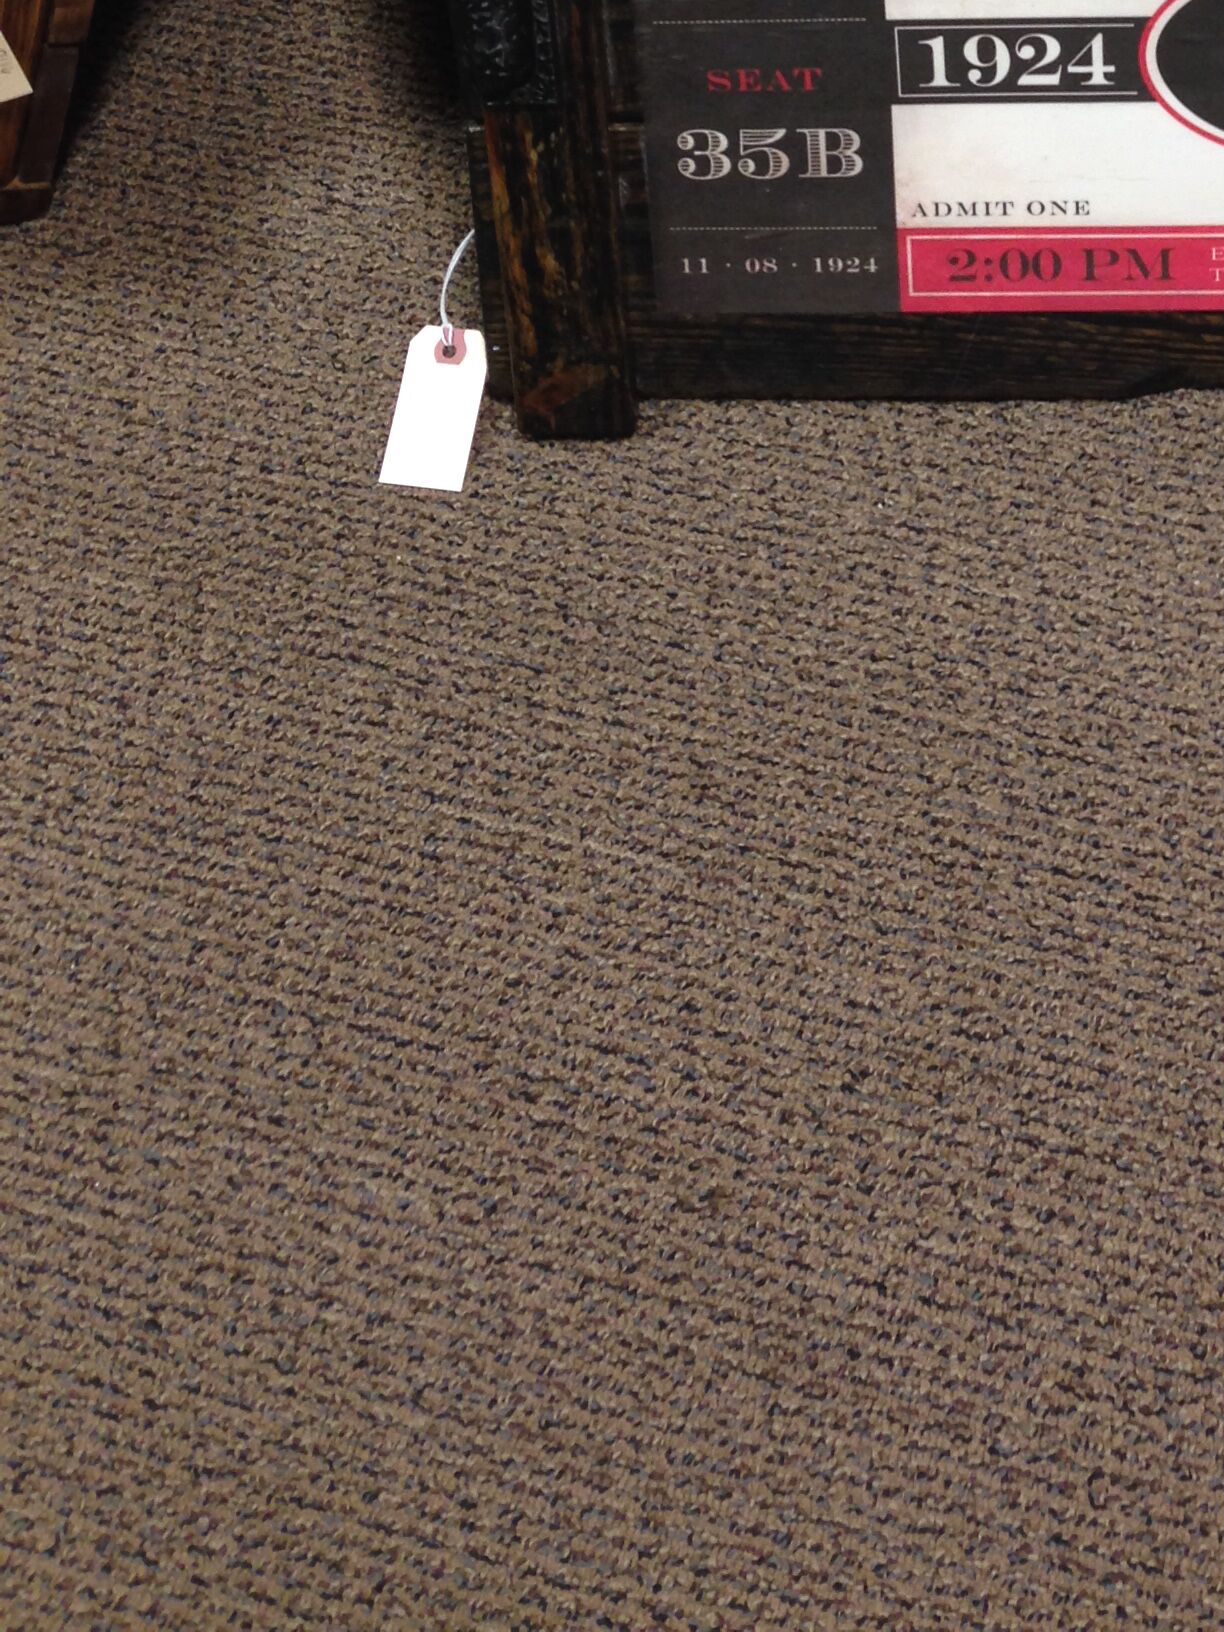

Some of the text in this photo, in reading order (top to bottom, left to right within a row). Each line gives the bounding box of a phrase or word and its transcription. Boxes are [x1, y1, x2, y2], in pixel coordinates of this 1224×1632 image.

[916, 32, 1117, 89] 1924
[706, 68, 823, 92] SEAT
[676, 127, 864, 181] 35B
[911, 200, 1092, 218] ADMIT ONE
[744, 256, 779, 275] 08
[812, 256, 879, 274] 1924
[946, 247, 1175, 284] 2:00 PM
